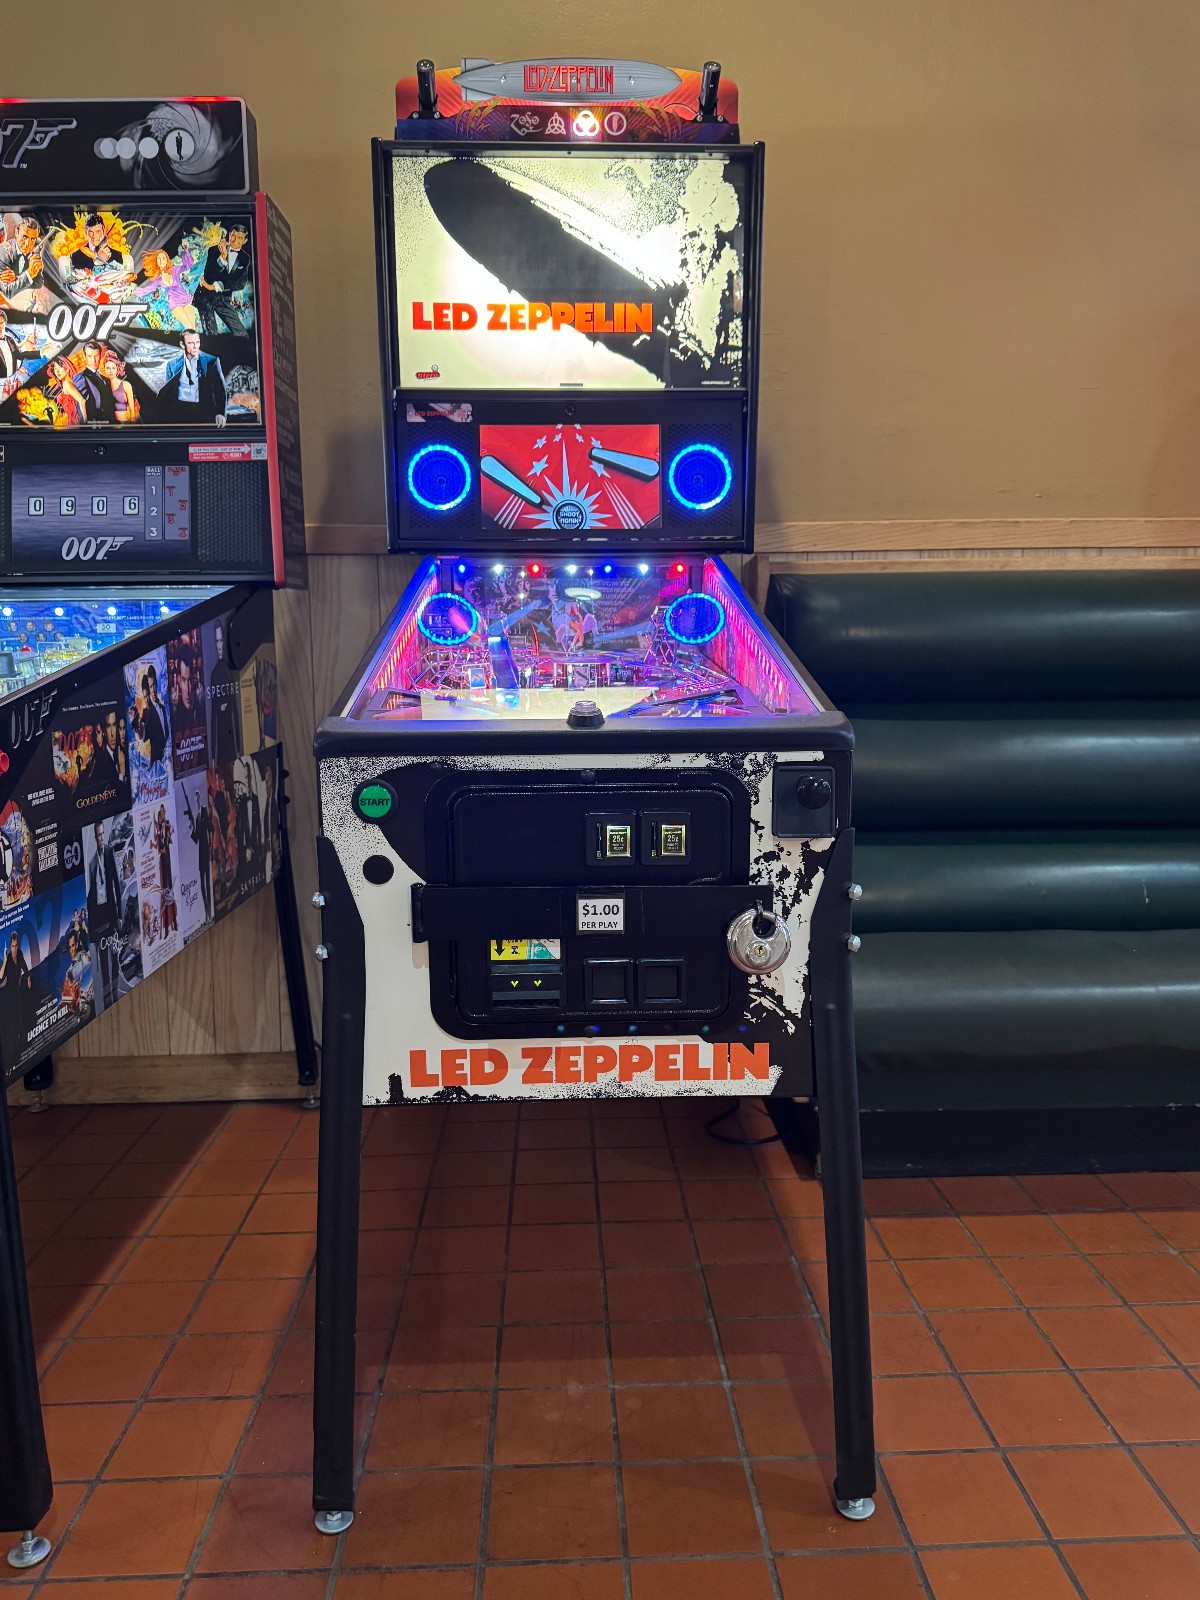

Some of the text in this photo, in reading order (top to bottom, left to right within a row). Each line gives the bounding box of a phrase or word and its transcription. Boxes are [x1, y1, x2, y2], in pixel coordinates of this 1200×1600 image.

[48, 304, 122, 341] 007
[412, 301, 653, 333] LED ZEPPELIN
[151, 485, 156, 496] 1
[33, 499, 42, 512] 0
[65, 499, 74, 512] 9
[96, 499, 105, 512] 0
[128, 498, 137, 510] 6
[150, 506, 158, 516] 2
[149, 527, 158, 537] 3
[61, 536, 116, 561] 007
[206, 681, 239, 699] SPECTRE
[360, 798, 390, 807] START
[582, 903, 619, 917] $1.00
[581, 921, 618, 929] PER PLAY
[27, 1018, 49, 1041] LICENCE
[50, 1013, 57, 1026] TO
[57, 1004, 69, 1020] KILL
[409, 1042, 771, 1088] LED ZEPPELIN
